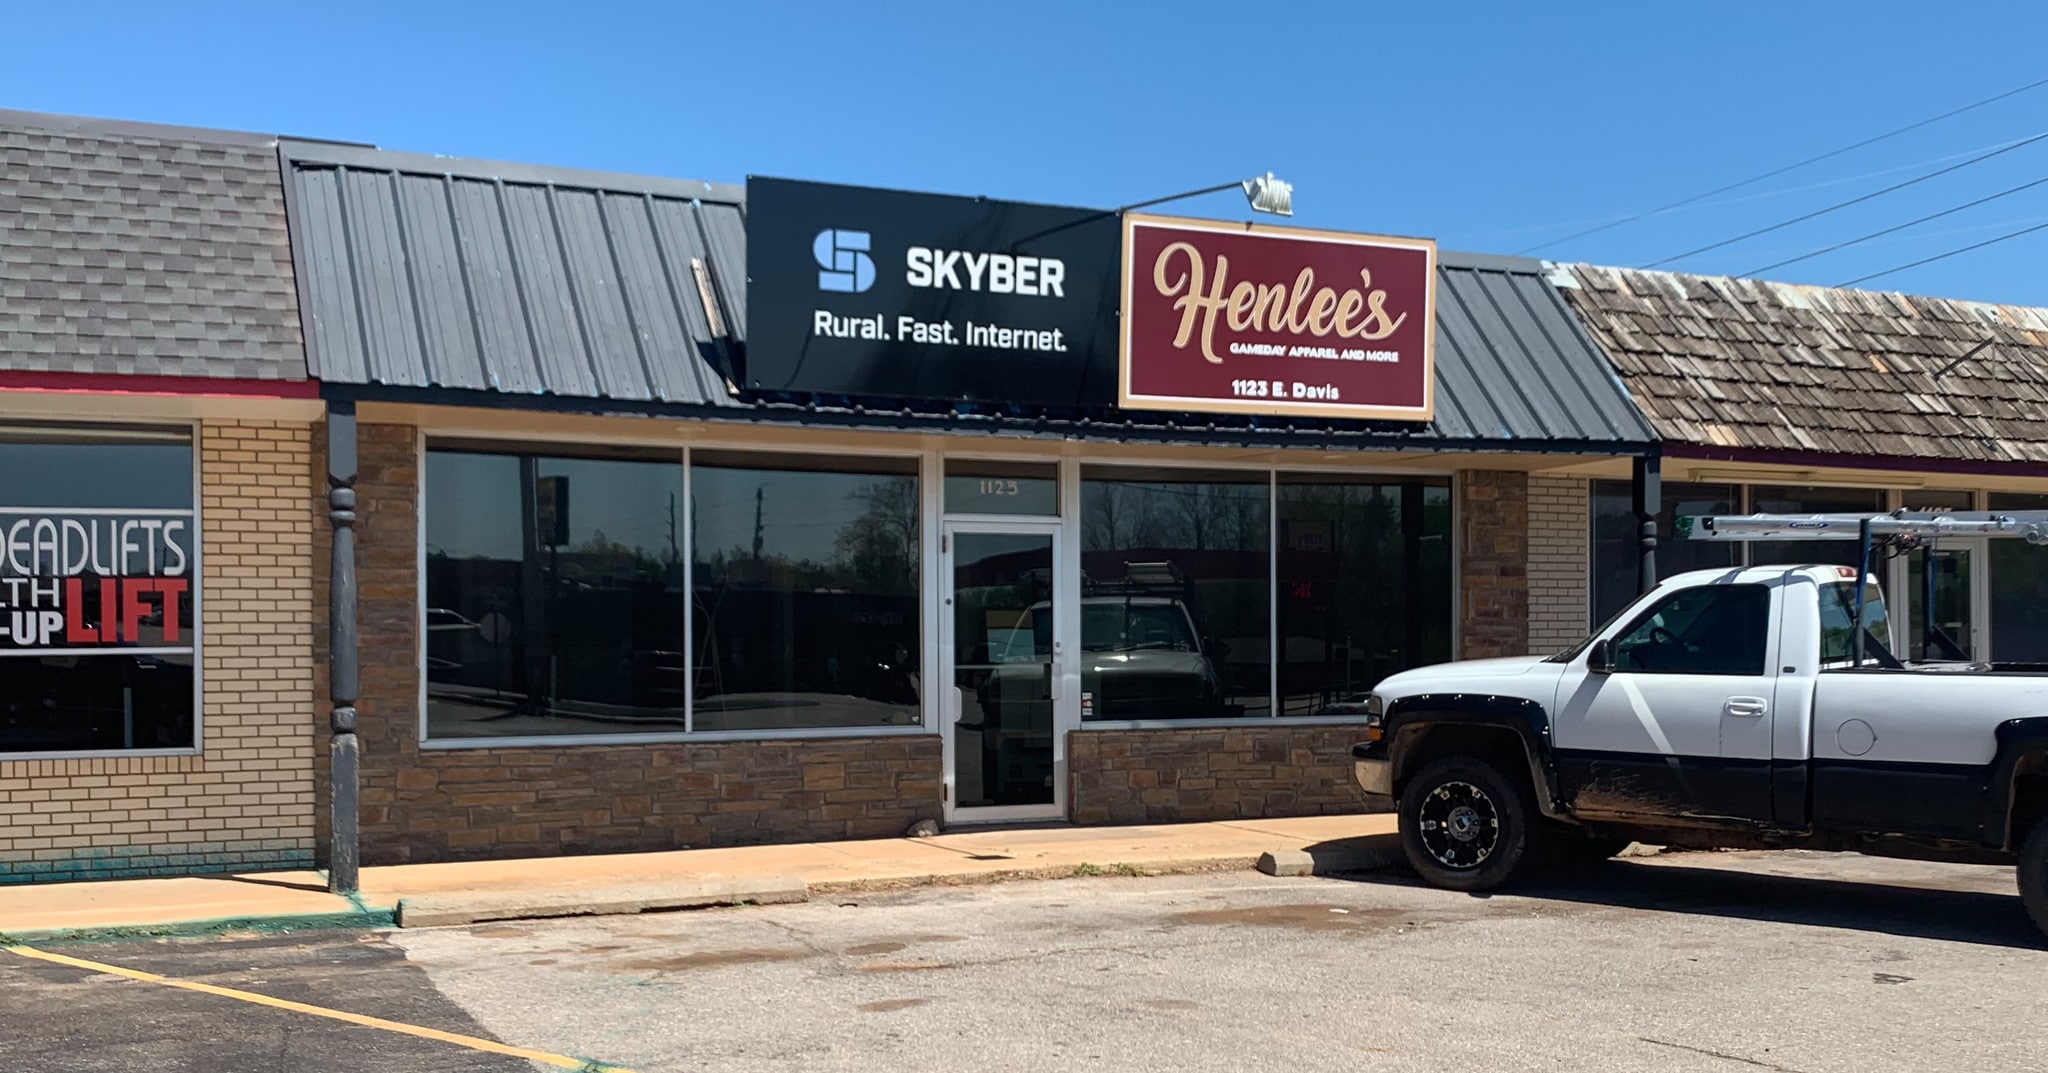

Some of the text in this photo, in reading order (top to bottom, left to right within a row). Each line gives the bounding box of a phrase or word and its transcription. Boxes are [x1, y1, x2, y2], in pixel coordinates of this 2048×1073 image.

[906, 246, 1065, 297] SKYBER
[1153, 241, 1407, 364] Henlee's
[814, 310, 1068, 352] Rural. Fast. Internet.
[1230, 342, 1399, 363] GAMEDAY APPAREL AND MORE
[1231, 379, 1340, 400] 1123 E. Davis
[980, 479, 1018, 496] 1123
[0, 517, 187, 577] EADLIFTS
[66, 578, 188, 643] LIFT
